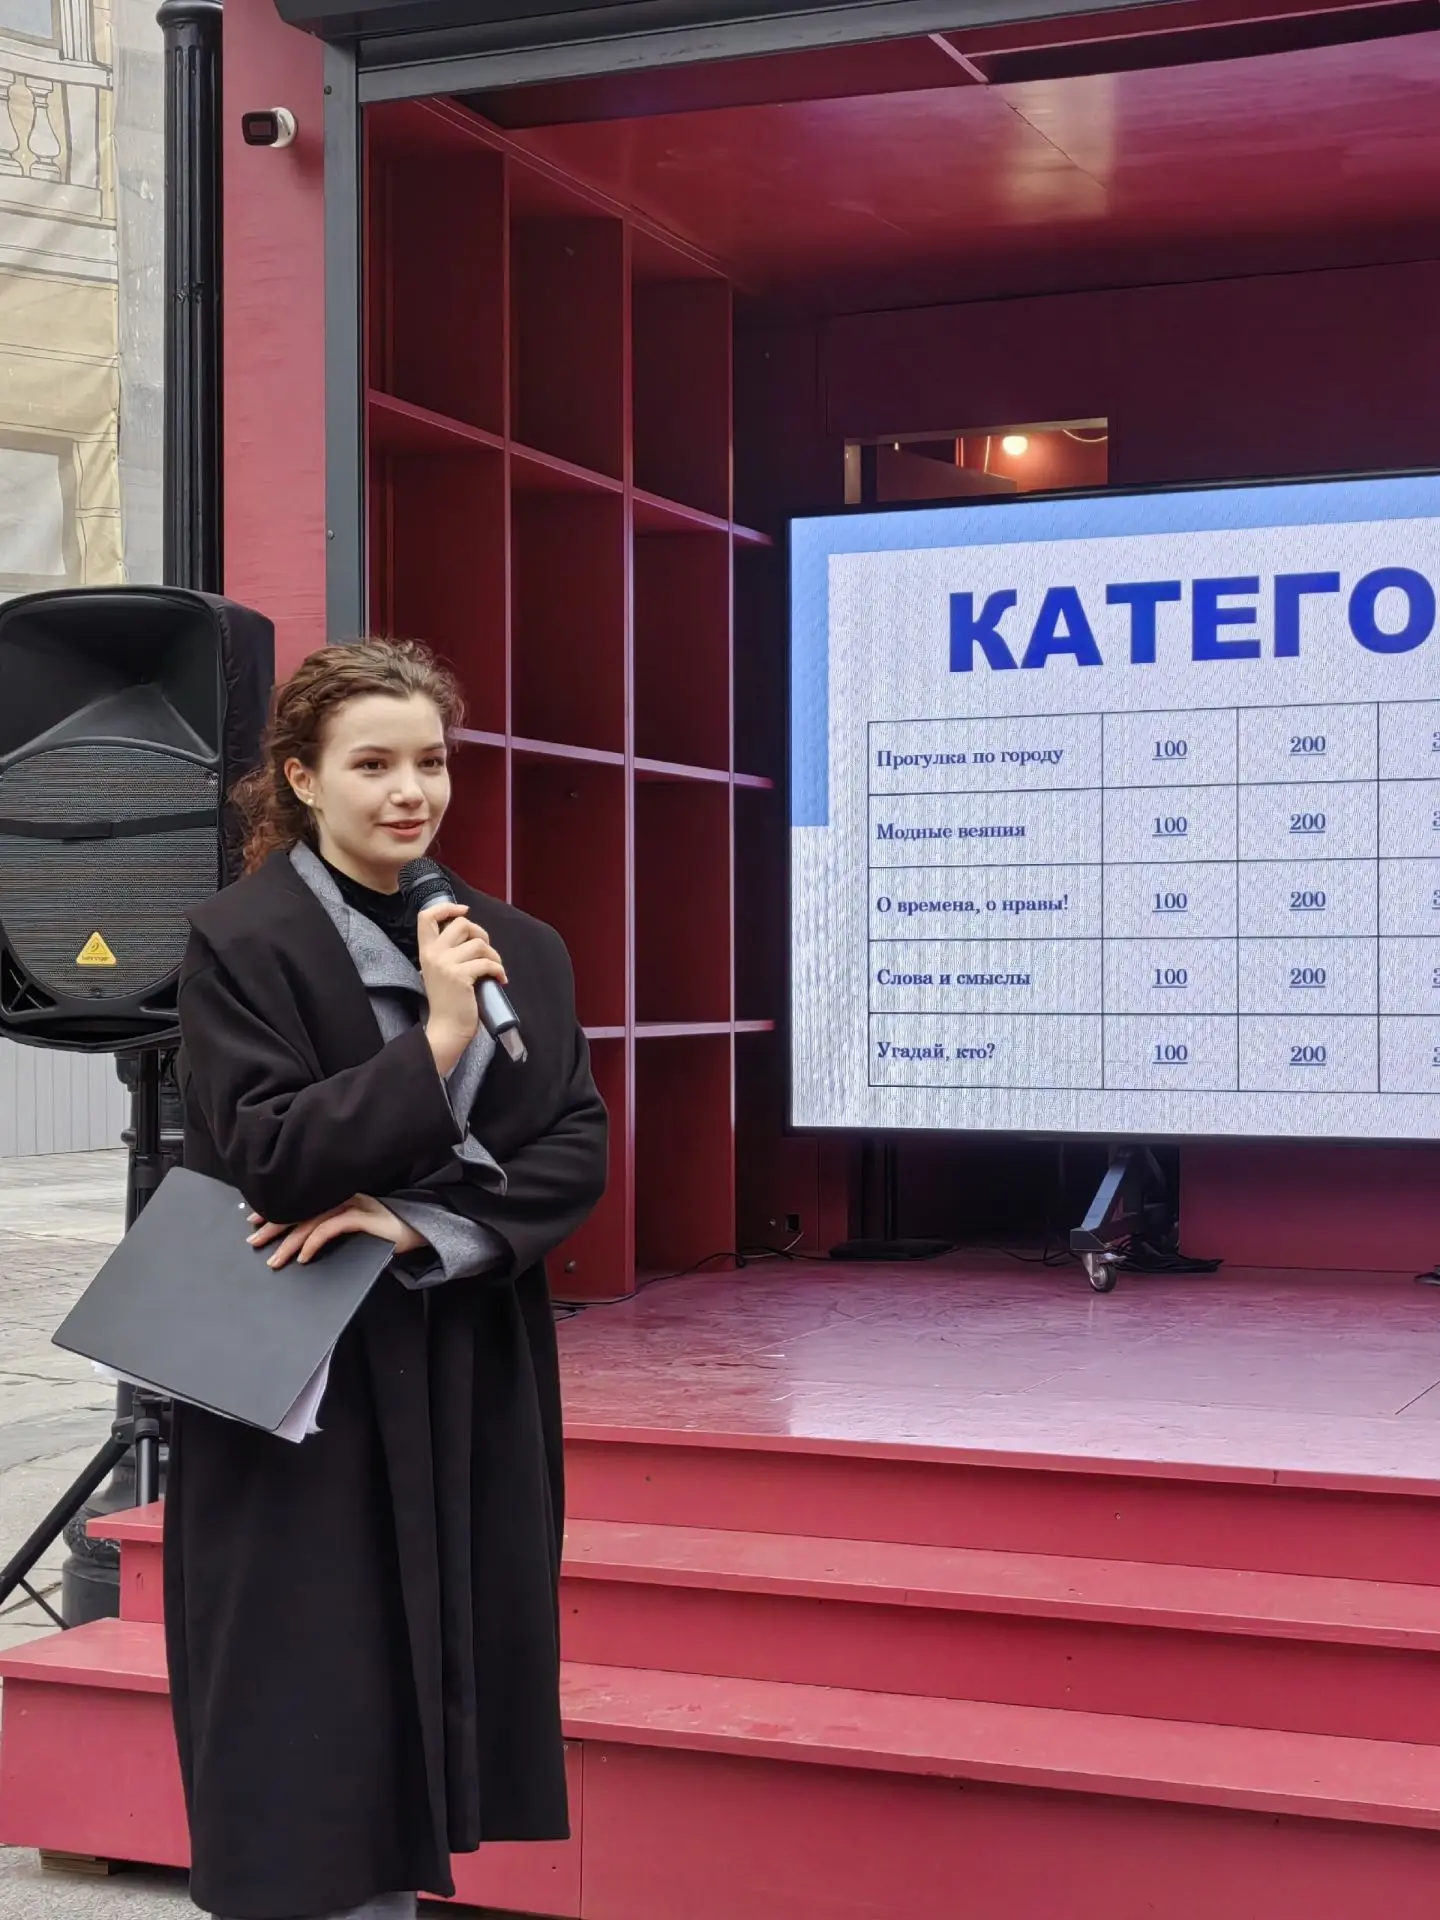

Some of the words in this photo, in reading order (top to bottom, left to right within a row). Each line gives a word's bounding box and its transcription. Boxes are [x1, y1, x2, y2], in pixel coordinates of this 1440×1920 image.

[948, 566, 1437, 673] КАТЕГО
[1153, 740, 1188, 758] 100
[1290, 736, 1326, 753] 200
[876, 750, 967, 770] Прогулка
[971, 752, 996, 764] по
[1000, 749, 1064, 766] городу
[1153, 817, 1188, 834] 100
[1290, 813, 1326, 830] 200
[876, 823, 953, 841] Модные
[958, 825, 1026, 839] веяния
[876, 896, 892, 913] О
[897, 899, 981, 916] времена,
[986, 899, 997, 911] о
[1002, 893, 1069, 914] нравы!
[1153, 893, 1188, 910] 100
[1290, 891, 1326, 908] 200
[876, 969, 934, 986] Слова
[939, 973, 951, 985] и
[956, 973, 1032, 986] смыслы
[1153, 968, 1188, 985] 100
[1290, 968, 1326, 985] 200
[876, 1041, 951, 1062] Угадай,
[956, 1043, 996, 1059] кто?
[1153, 1045, 1188, 1061] 100
[1290, 1046, 1327, 1062] 200
